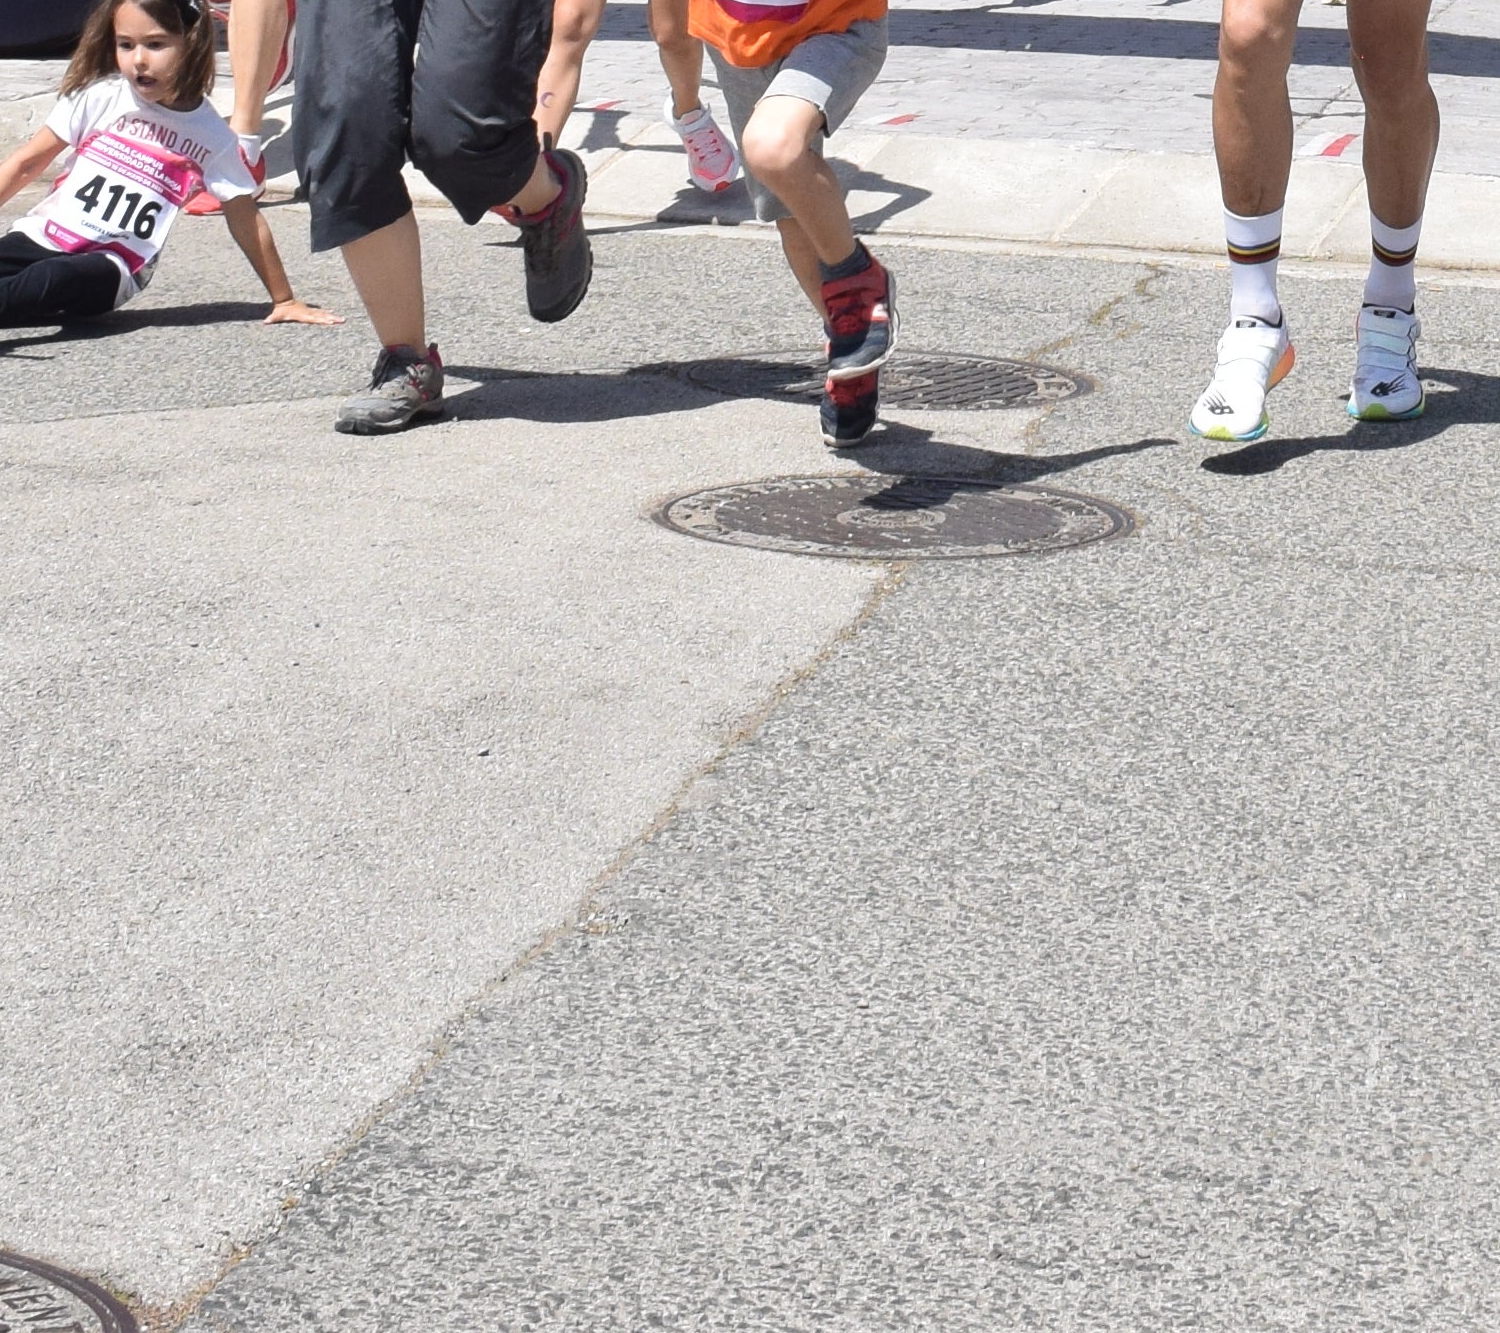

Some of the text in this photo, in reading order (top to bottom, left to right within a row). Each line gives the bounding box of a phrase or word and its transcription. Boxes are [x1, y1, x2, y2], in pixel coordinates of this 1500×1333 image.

[128, 118, 178, 149] STAND
[180, 138, 211, 165] OUT
[75, 174, 163, 240] 4116
